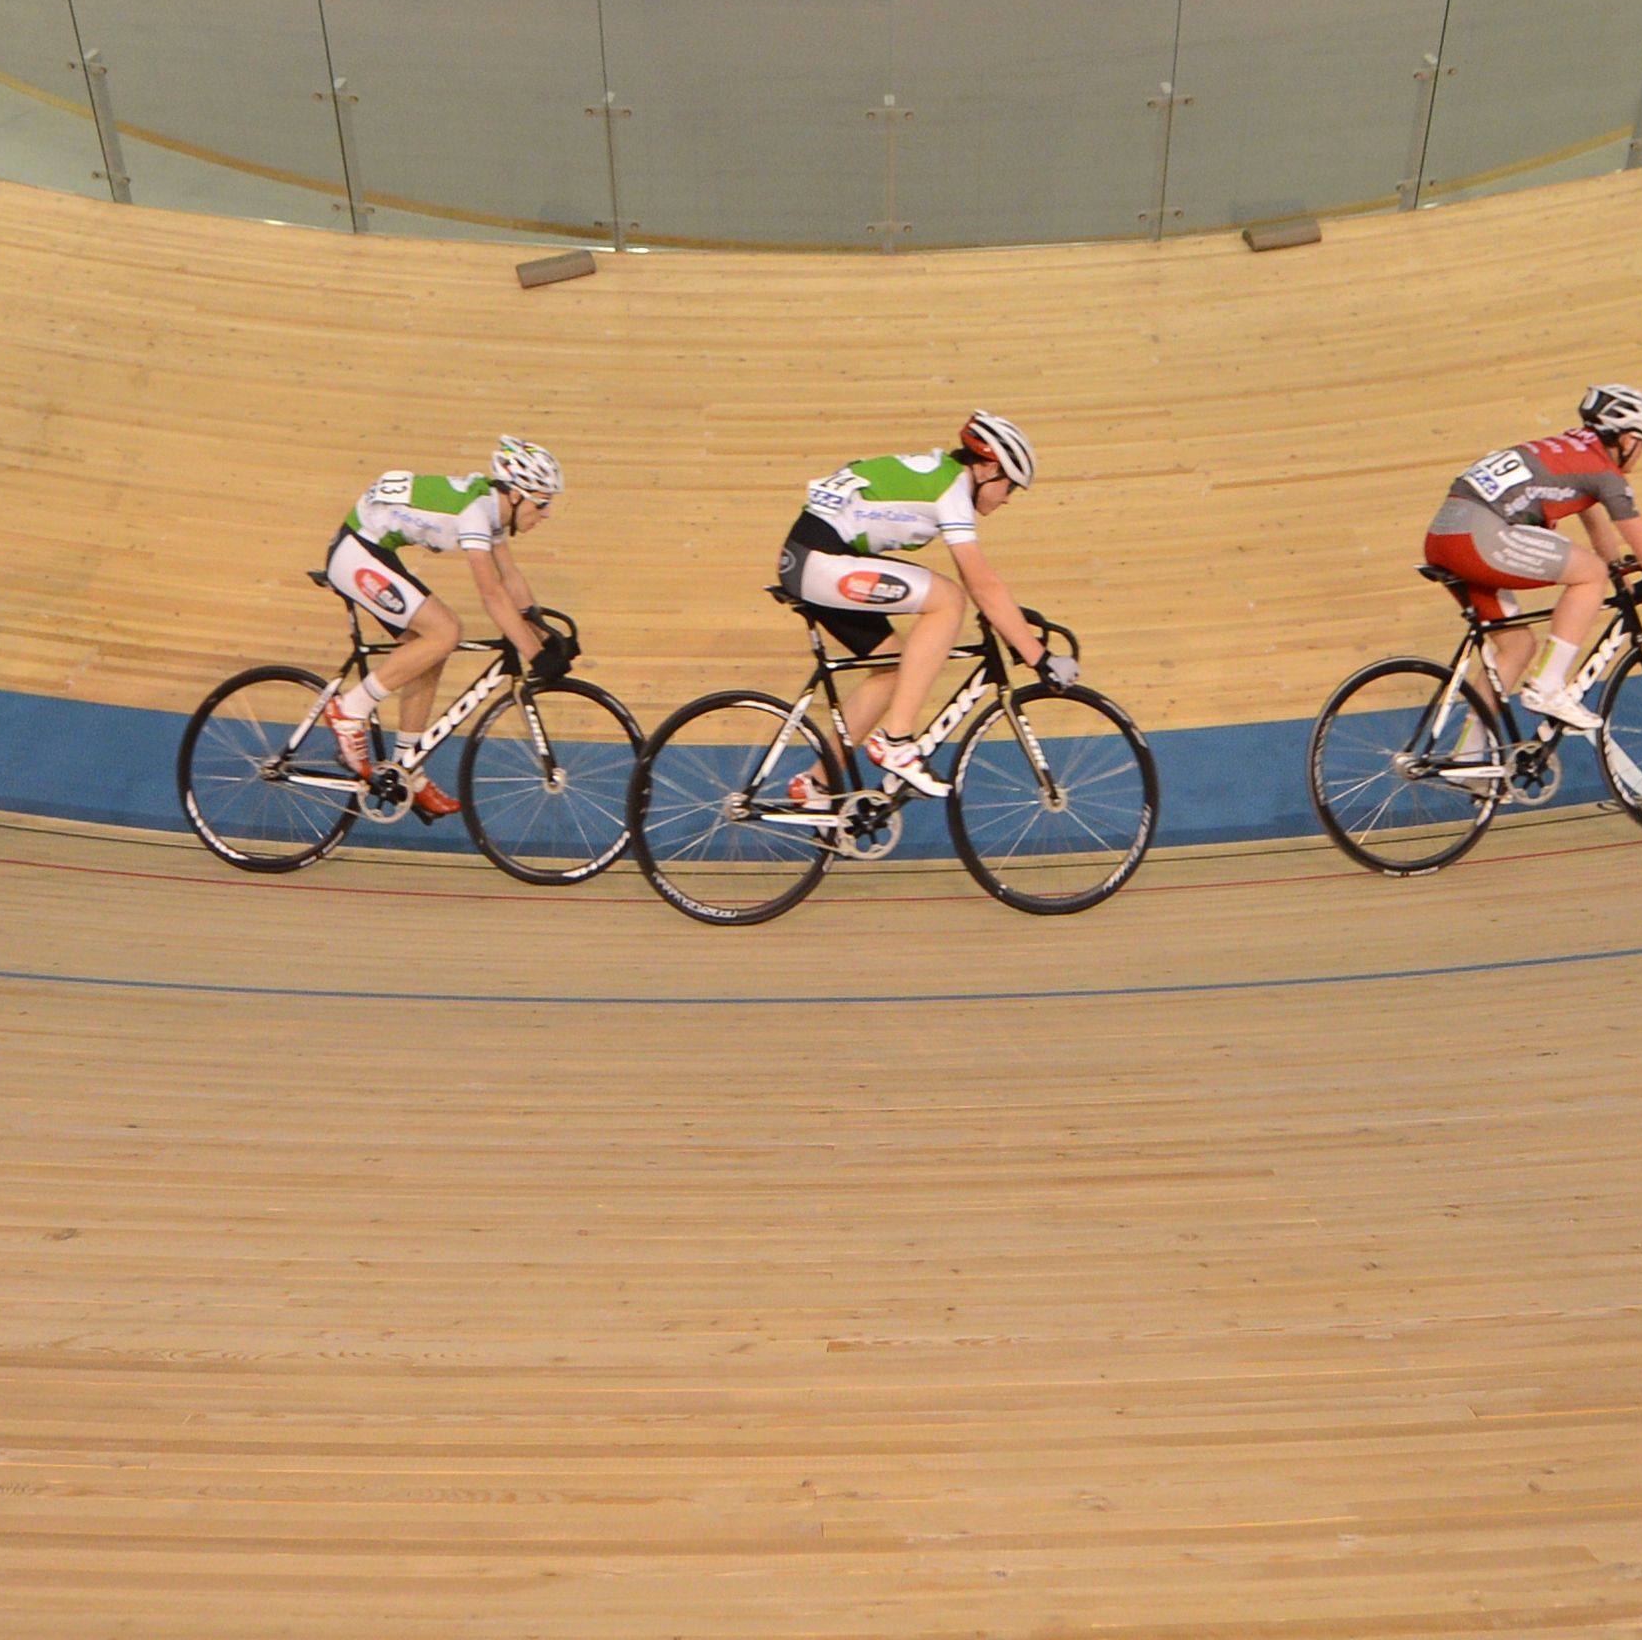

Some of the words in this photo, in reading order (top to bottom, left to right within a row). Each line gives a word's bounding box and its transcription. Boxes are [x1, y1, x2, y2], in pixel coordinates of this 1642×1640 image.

[1484, 451, 1520, 477] 19
[379, 476, 409, 495] 13
[403, 658, 509, 768] LOOK
